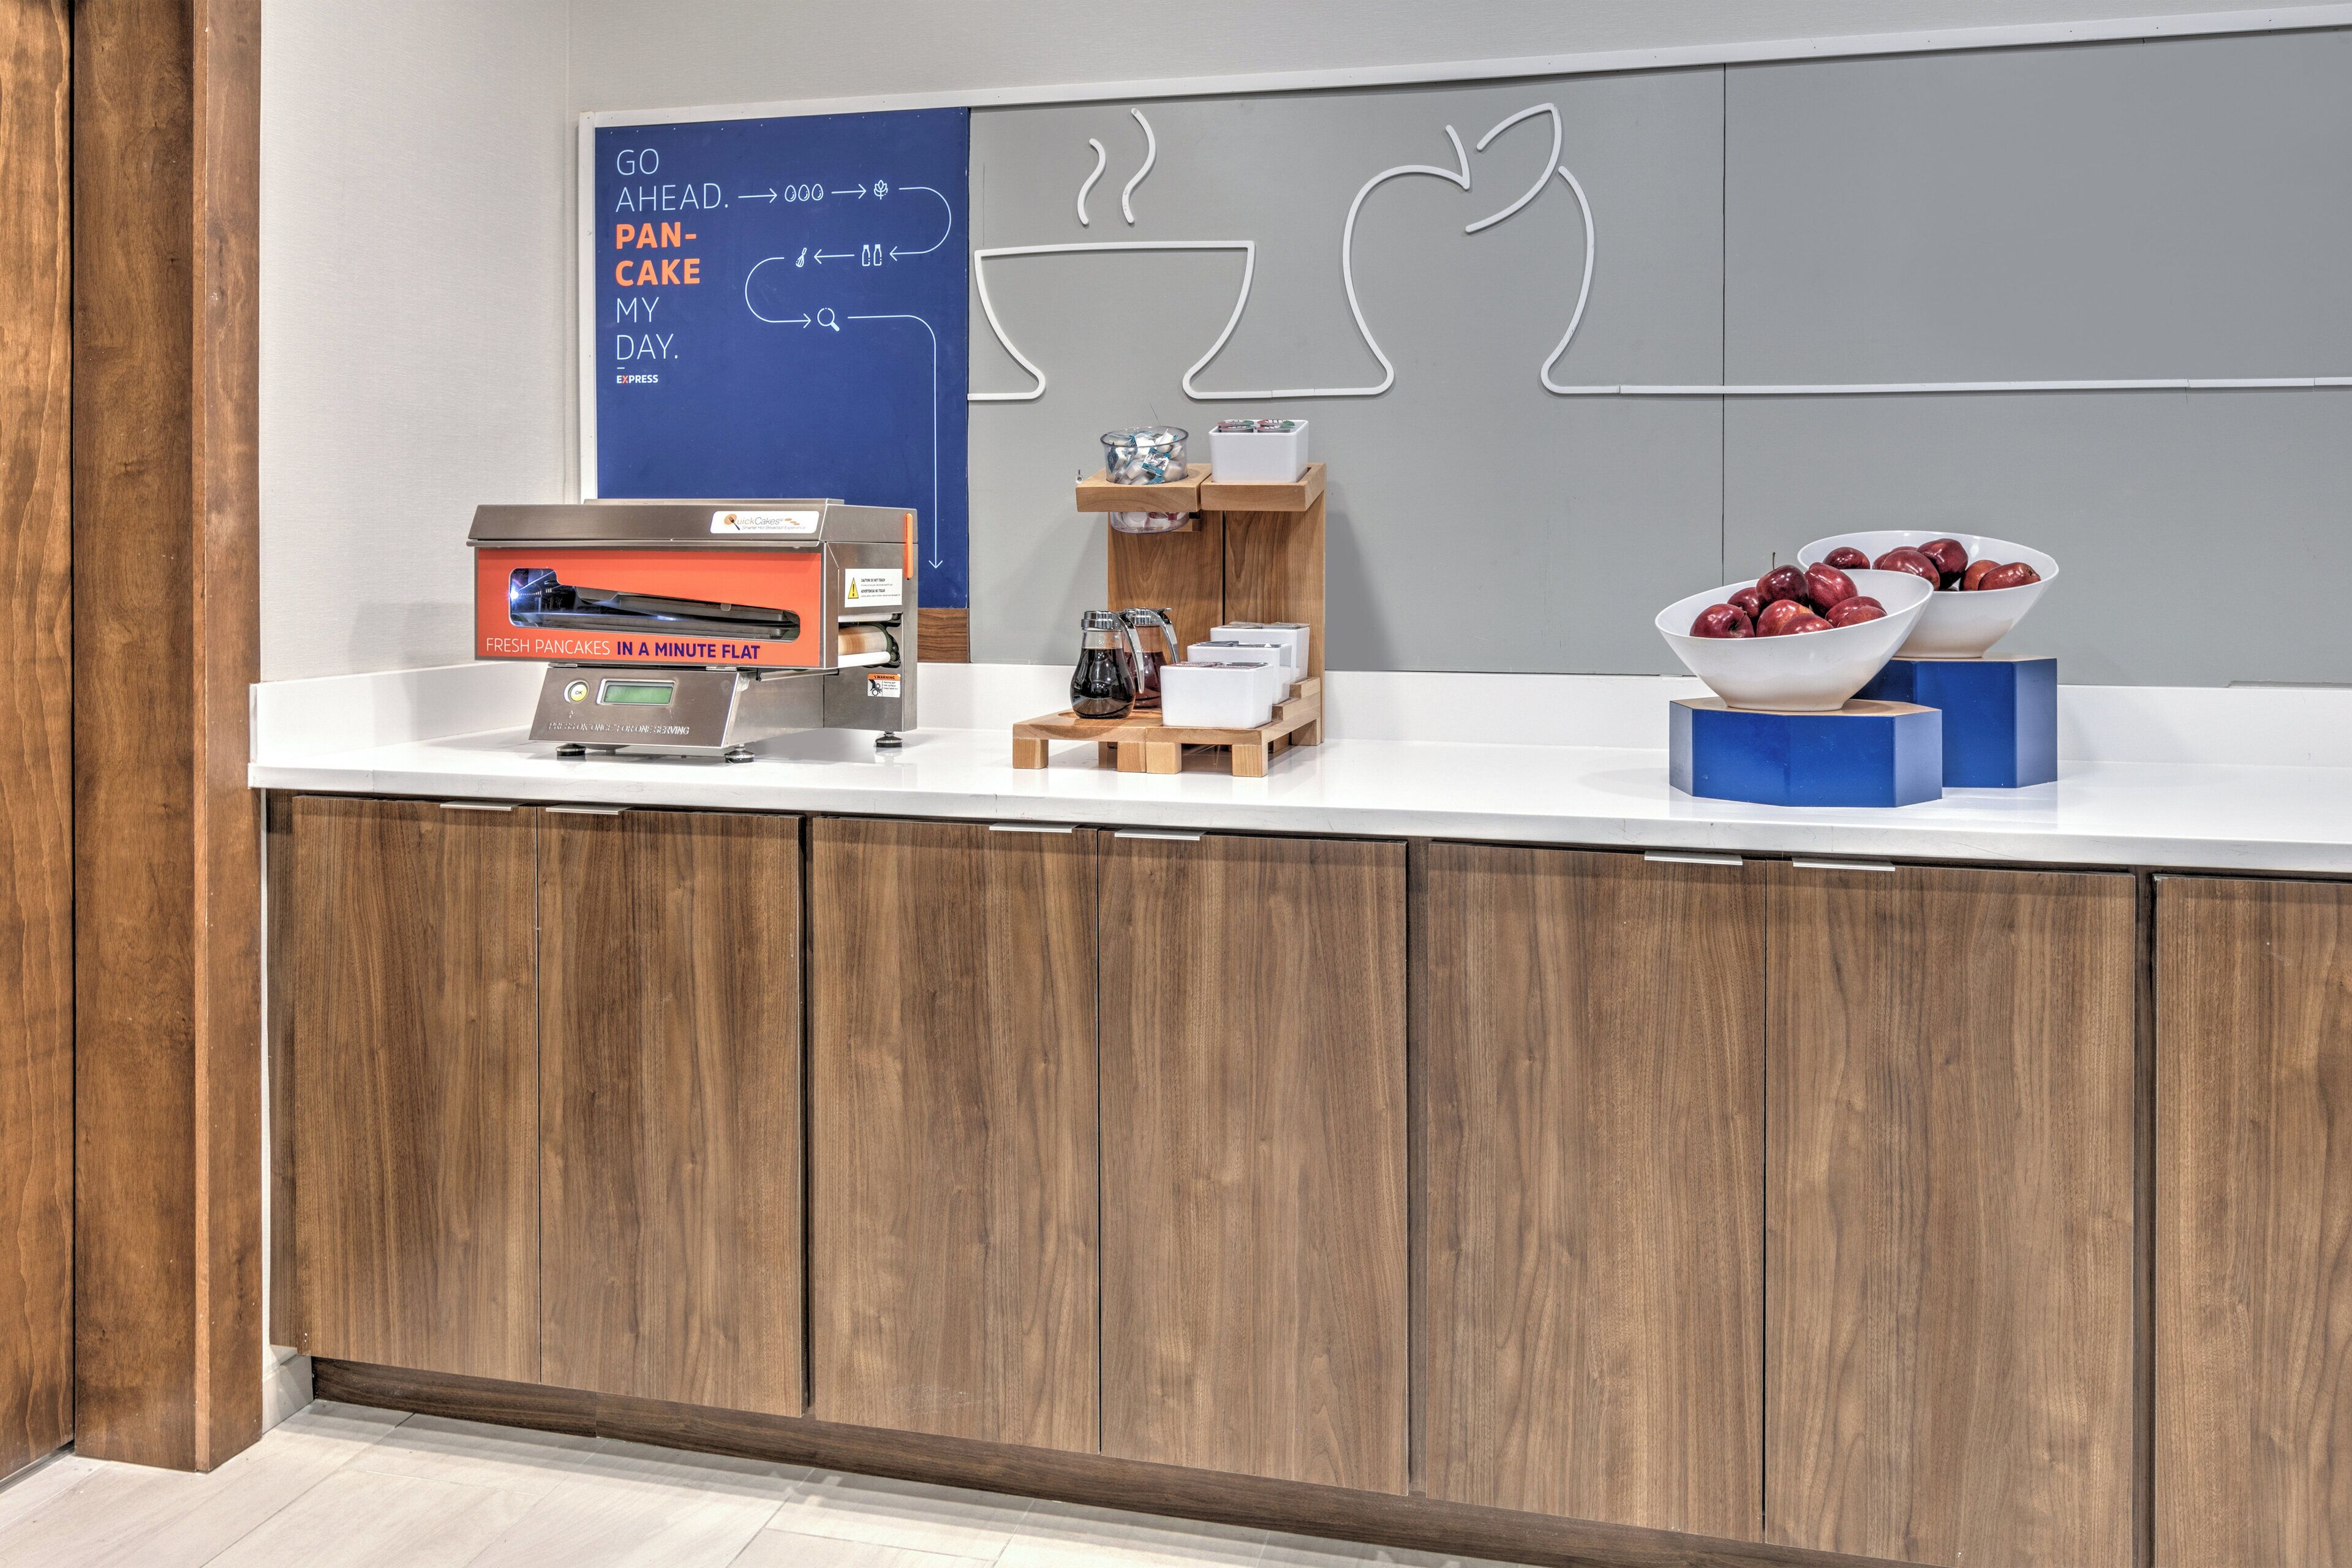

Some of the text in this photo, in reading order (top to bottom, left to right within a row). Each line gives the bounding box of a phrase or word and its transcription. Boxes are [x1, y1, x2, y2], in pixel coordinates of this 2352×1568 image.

[616, 148, 660, 175] GO
[615, 183, 729, 213] AHEAD.
[616, 222, 697, 250] PAN-
[616, 258, 700, 287] CAKE
[616, 296, 660, 323] MY
[616, 333, 679, 360] DAY.
[616, 374, 658, 384] EXPRESS
[486, 638, 760, 660] FRESH PANCAKES IN A MINUTE FLAT
[653, 725, 690, 735] SERVING
